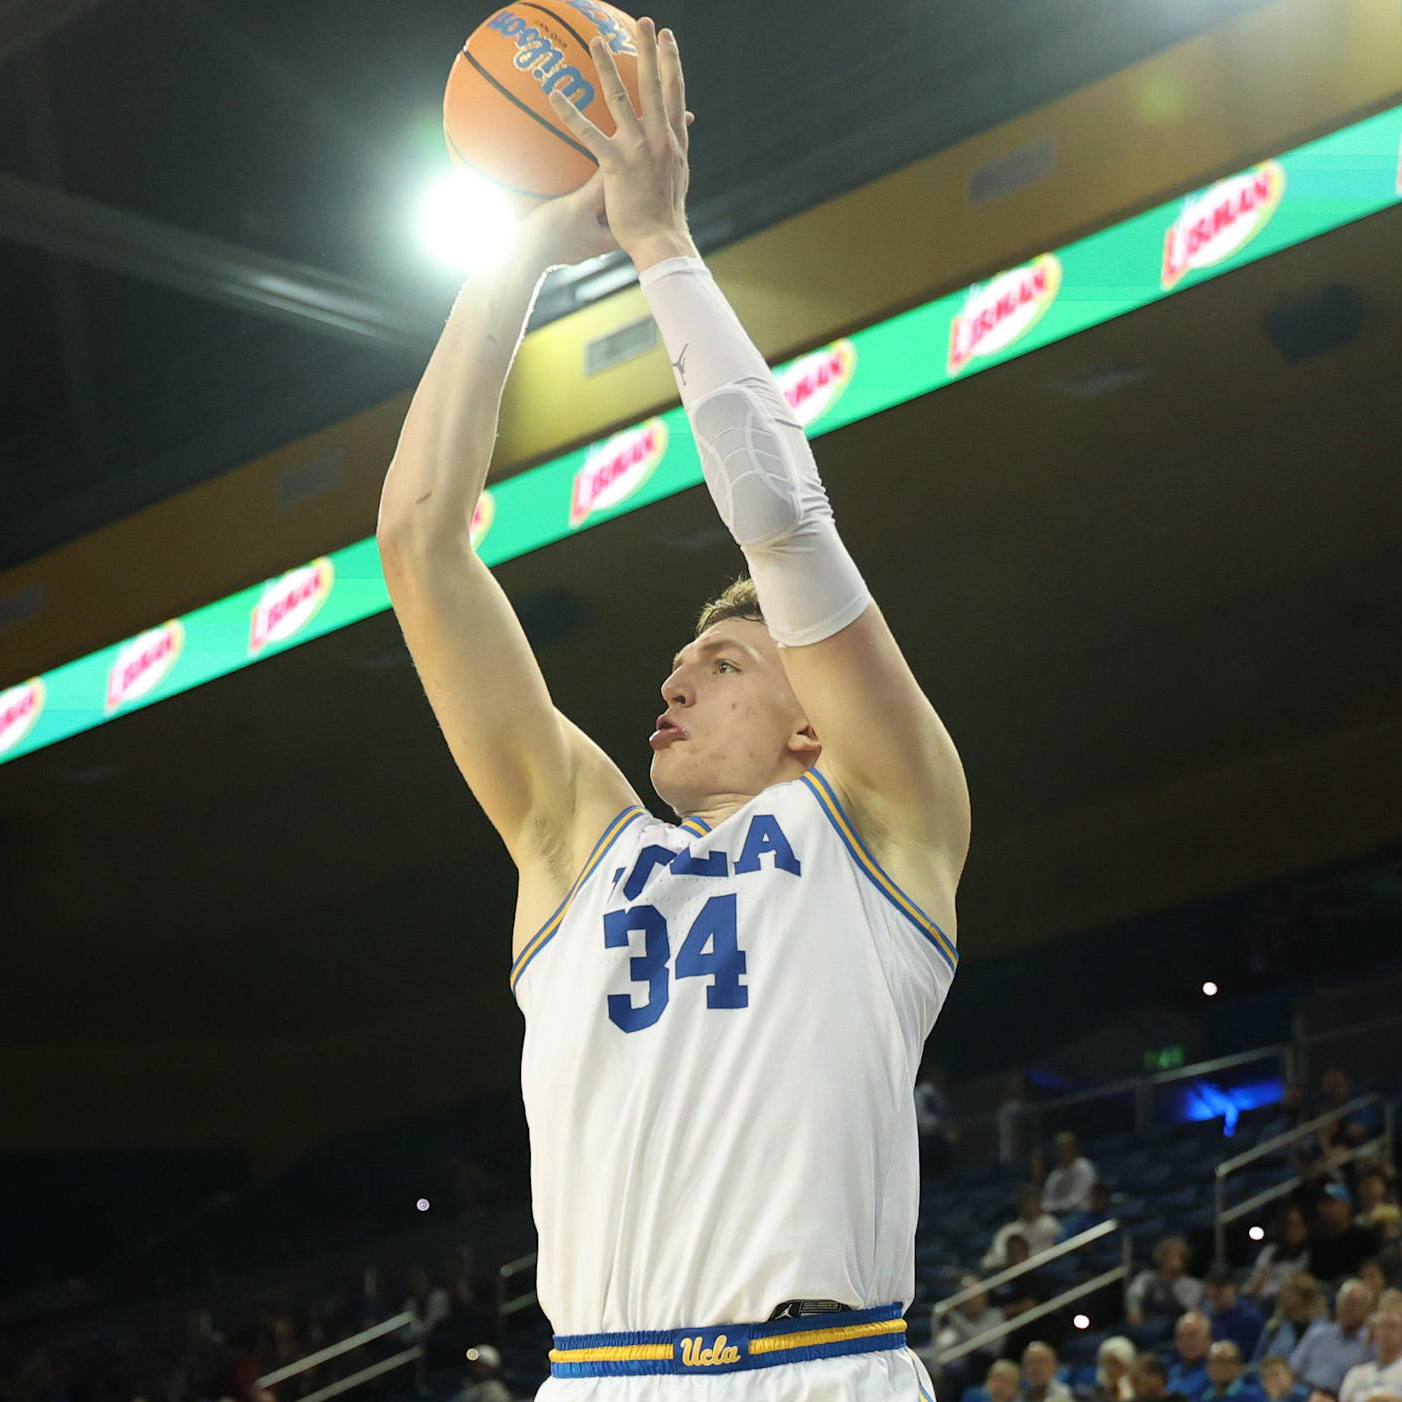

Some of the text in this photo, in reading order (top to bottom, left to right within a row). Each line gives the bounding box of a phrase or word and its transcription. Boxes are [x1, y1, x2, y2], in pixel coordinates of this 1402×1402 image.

[489, 10, 596, 112] Wilson
[603, 894, 749, 1034] 34
[679, 1334, 741, 1368] Ucla
